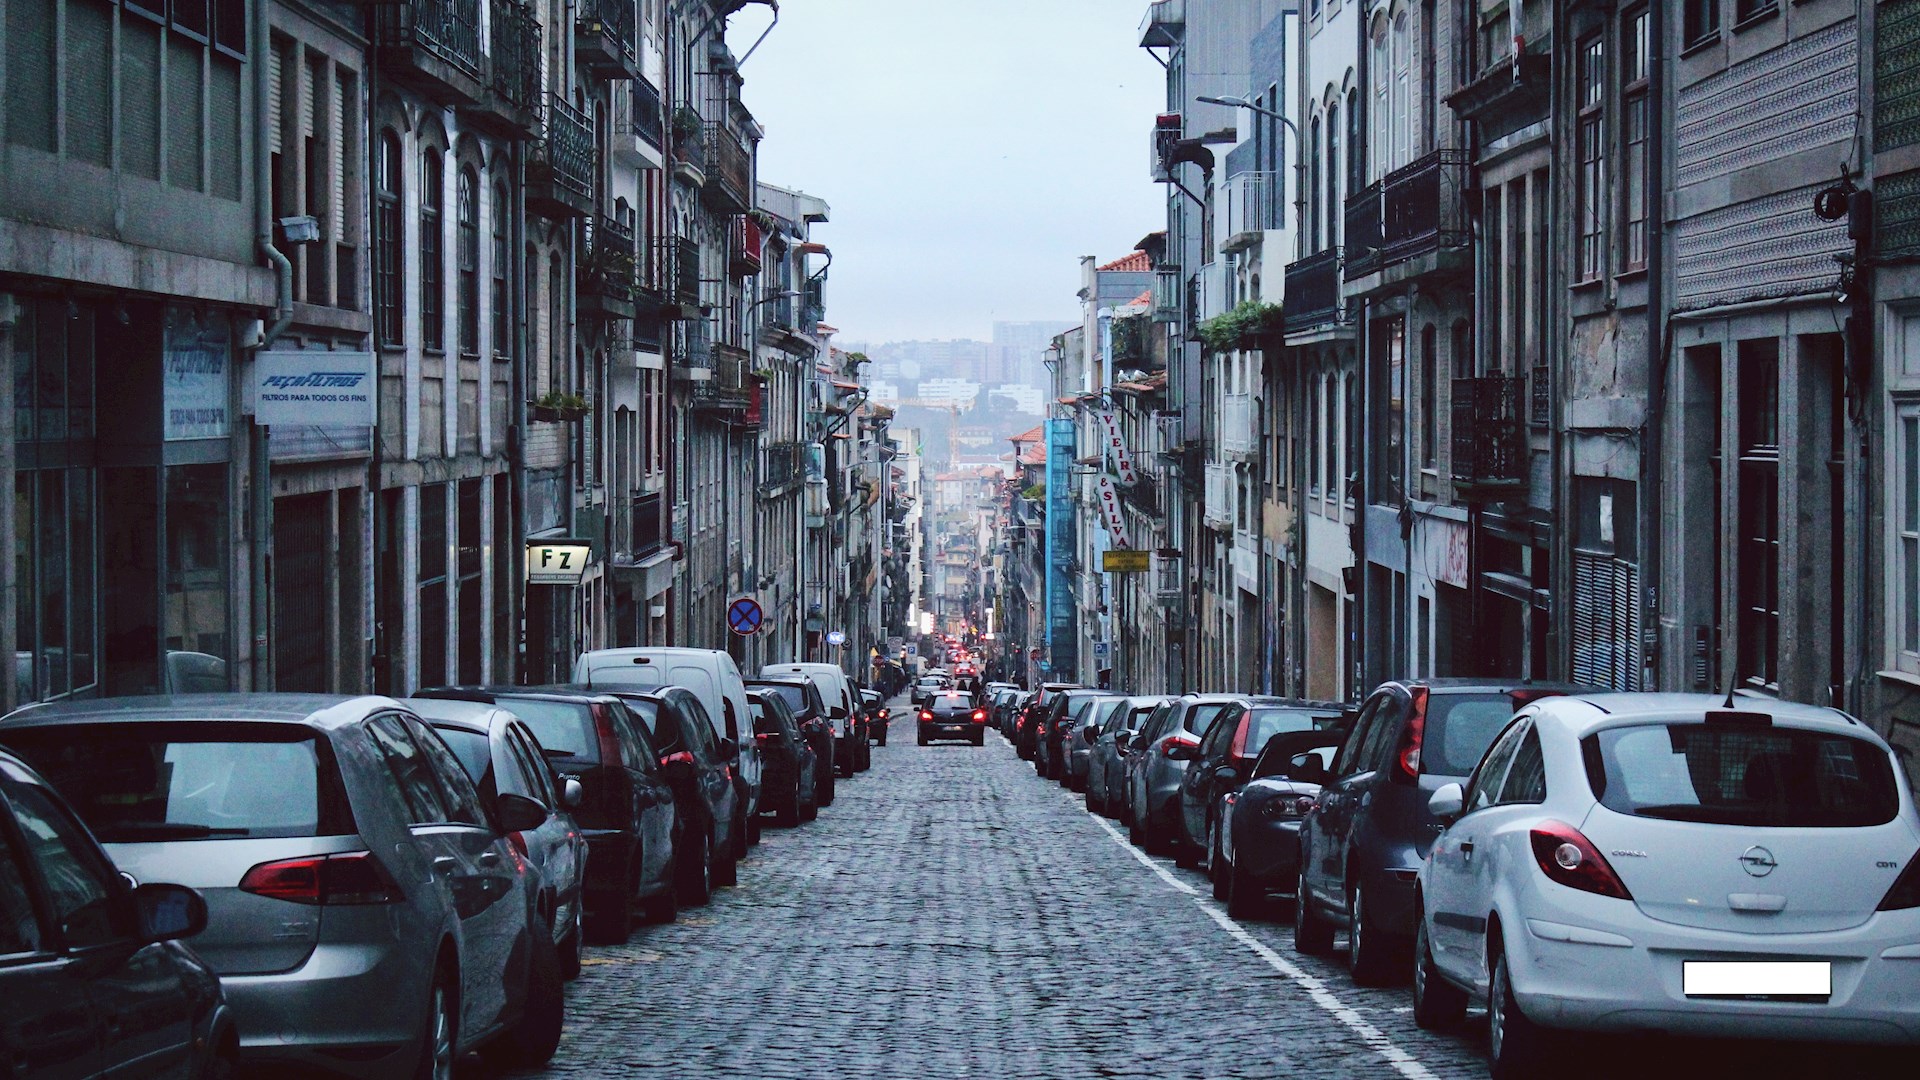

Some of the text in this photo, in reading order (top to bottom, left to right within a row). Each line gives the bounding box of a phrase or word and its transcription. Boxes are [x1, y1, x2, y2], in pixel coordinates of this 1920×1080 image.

[262, 372, 366, 389] PEÇAFILTROS
[262, 394, 367, 402] FILTROS PARA TODOS OS FINS
[1102, 415, 1135, 482] VIEIRA
[1101, 477, 1108, 487] &
[1103, 491, 1128, 546] SILVA
[558, 772, 580, 781] Punto
[1611, 849, 1648, 858] CORSA
